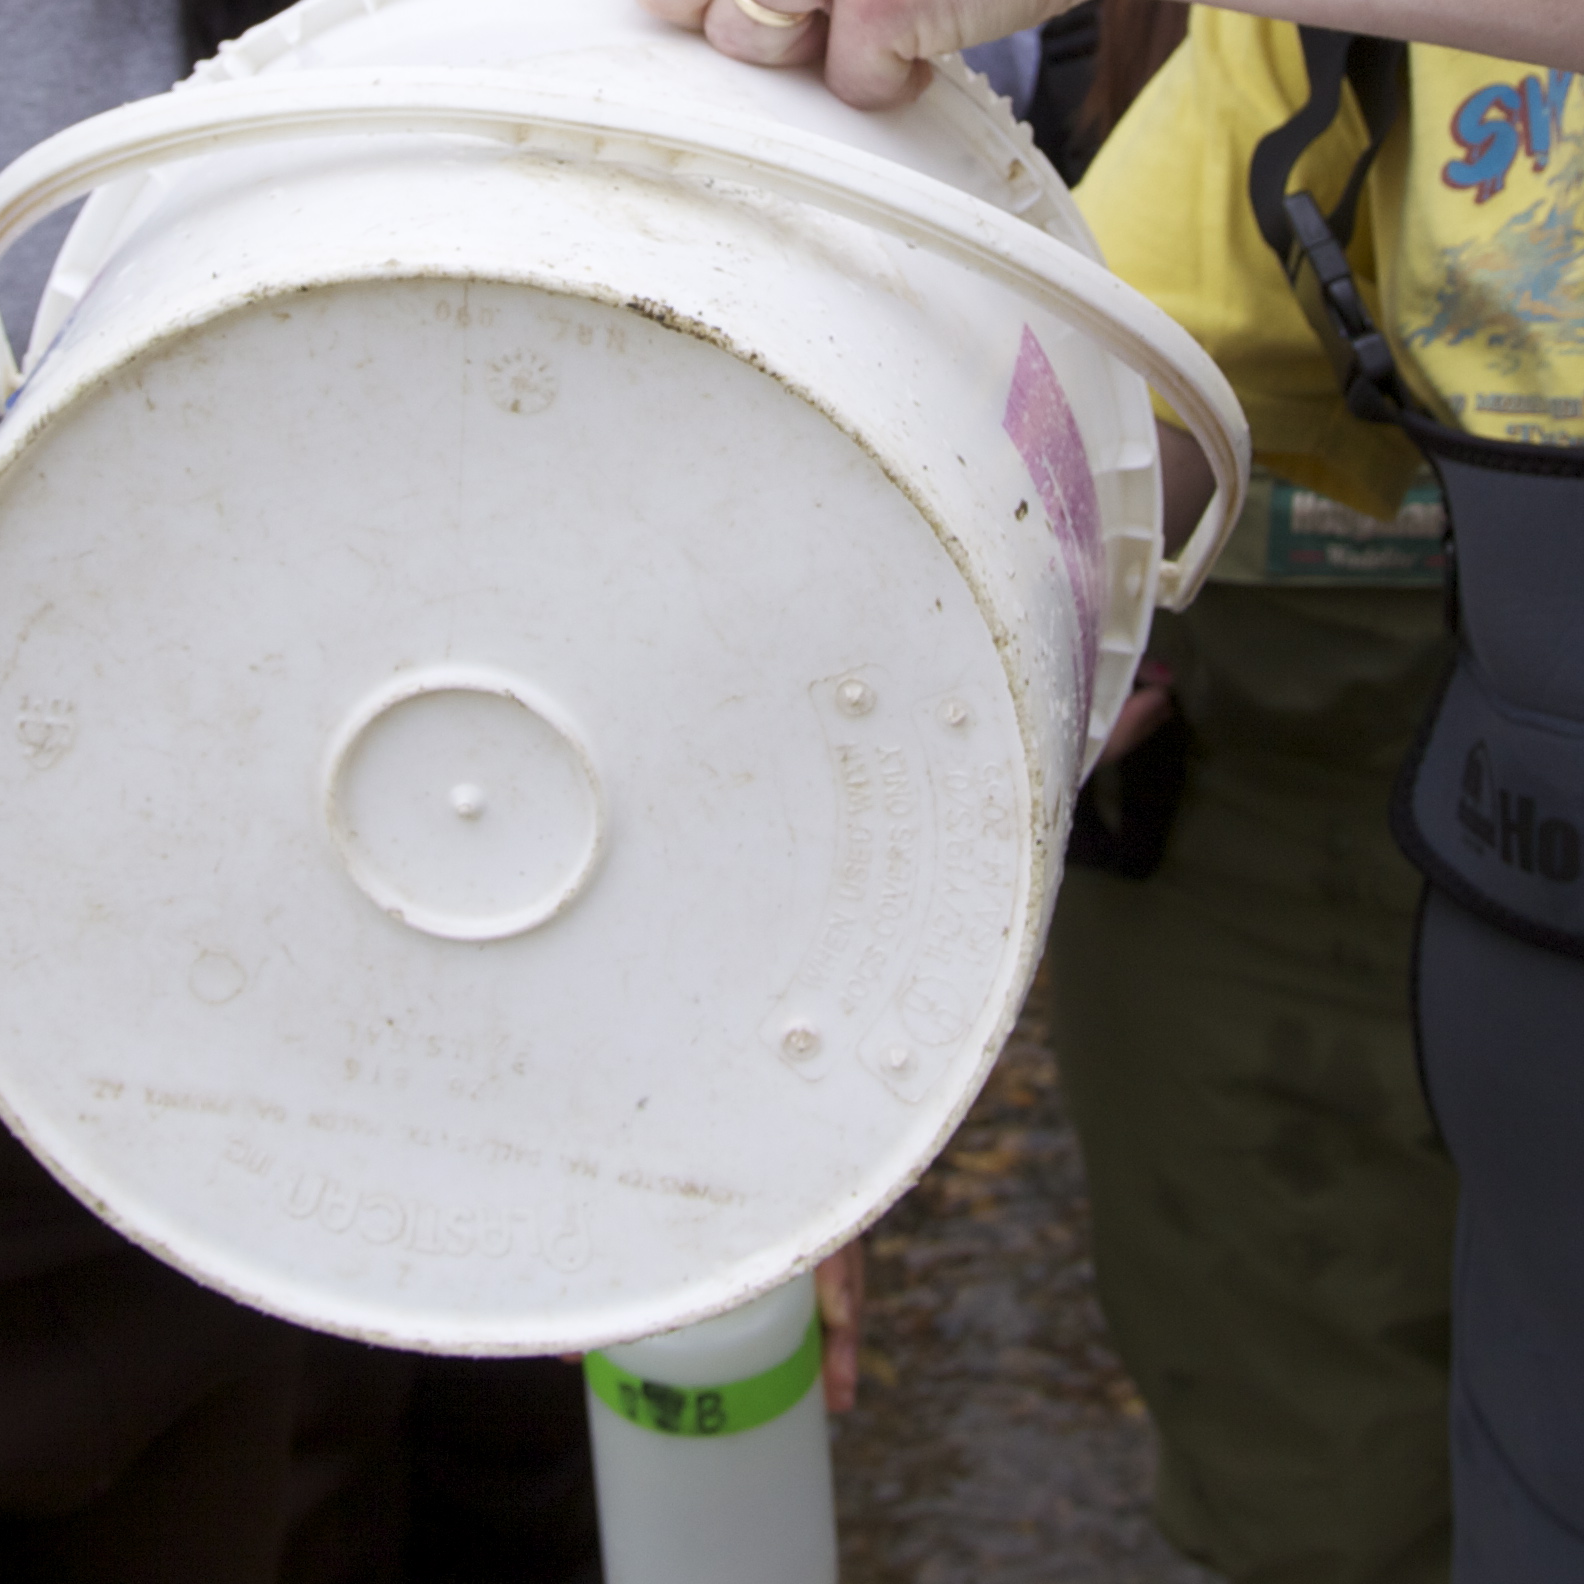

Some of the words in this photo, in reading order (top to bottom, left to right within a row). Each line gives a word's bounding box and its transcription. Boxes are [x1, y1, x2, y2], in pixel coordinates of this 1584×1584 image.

[834, 742, 874, 817] WITH
[873, 744, 915, 818] ONLY
[836, 826, 874, 903] USED
[872, 823, 920, 939] COVERS
[281, 1171, 593, 1274] PLASTICAN
